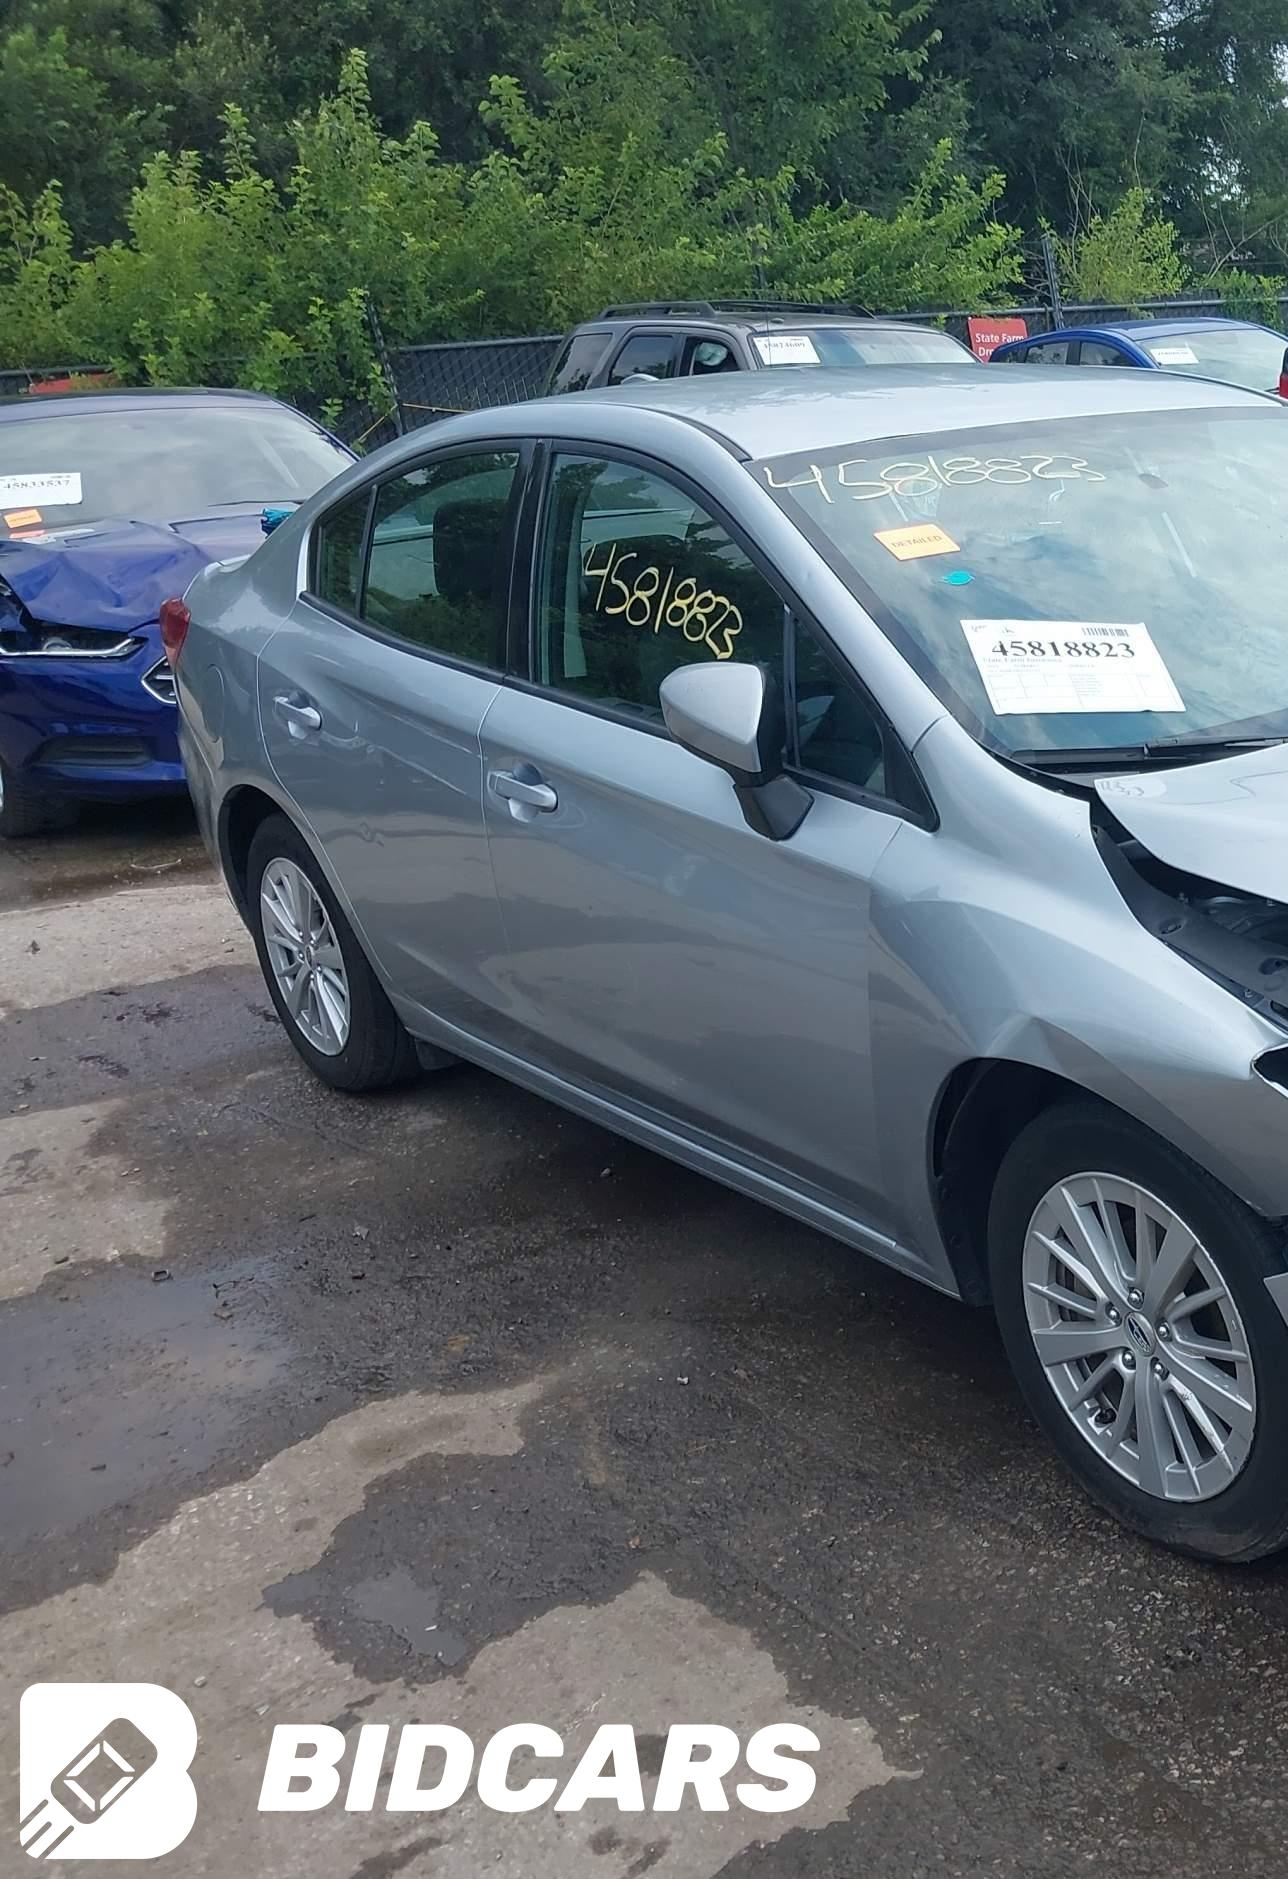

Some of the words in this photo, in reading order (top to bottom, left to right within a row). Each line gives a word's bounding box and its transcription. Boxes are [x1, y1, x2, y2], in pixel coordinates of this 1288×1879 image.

[975, 333, 1000, 343] State
[1001, 333, 1025, 343] Farm
[763, 455, 1107, 504] 45818823
[585, 542, 743, 660] 45818823
[991, 640, 1136, 658] 45818823
